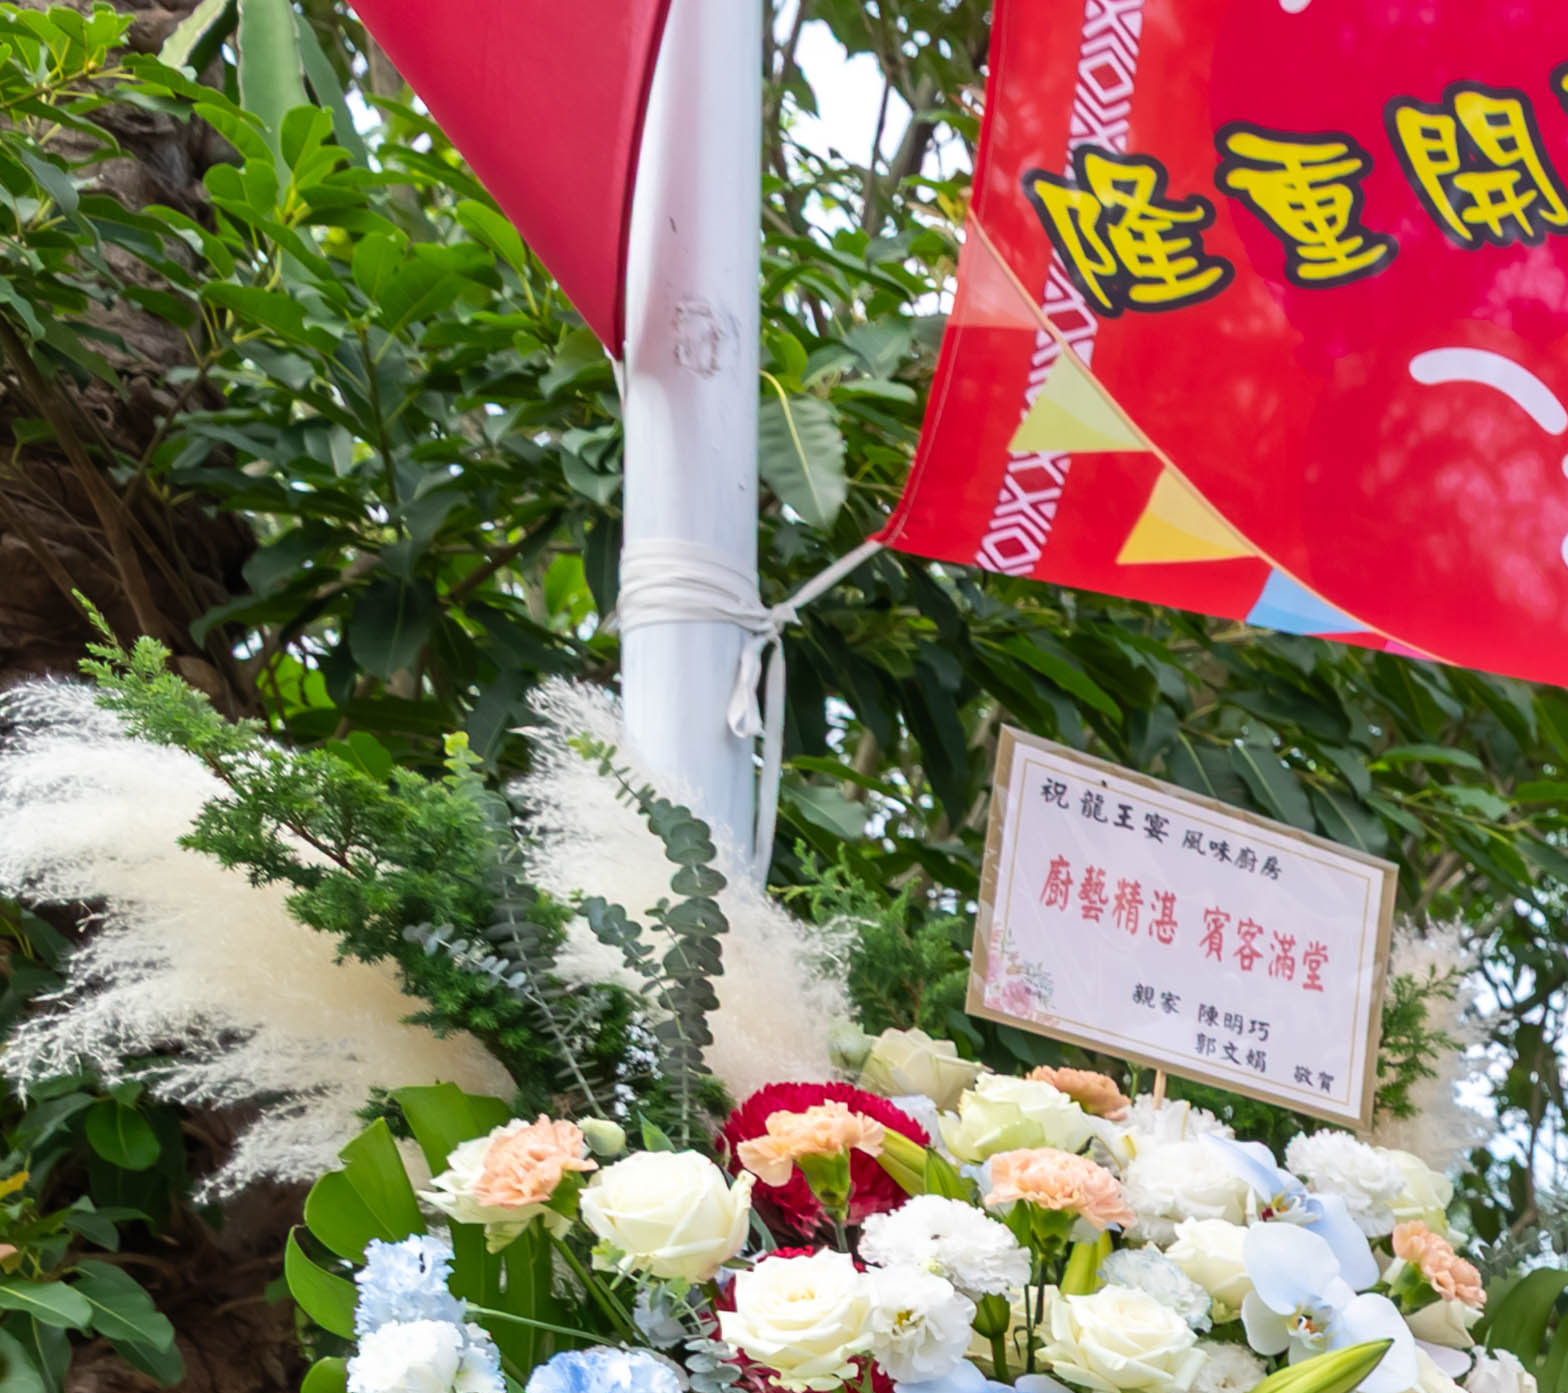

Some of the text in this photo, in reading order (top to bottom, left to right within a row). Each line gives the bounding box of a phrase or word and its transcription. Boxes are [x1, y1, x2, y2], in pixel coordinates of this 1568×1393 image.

[1182, 828, 1282, 881] 風味廚房
[1040, 853, 1330, 993] 廚藝精湛 賓客滿堂
[1132, 981, 1271, 1041] 親家 陳明巧
